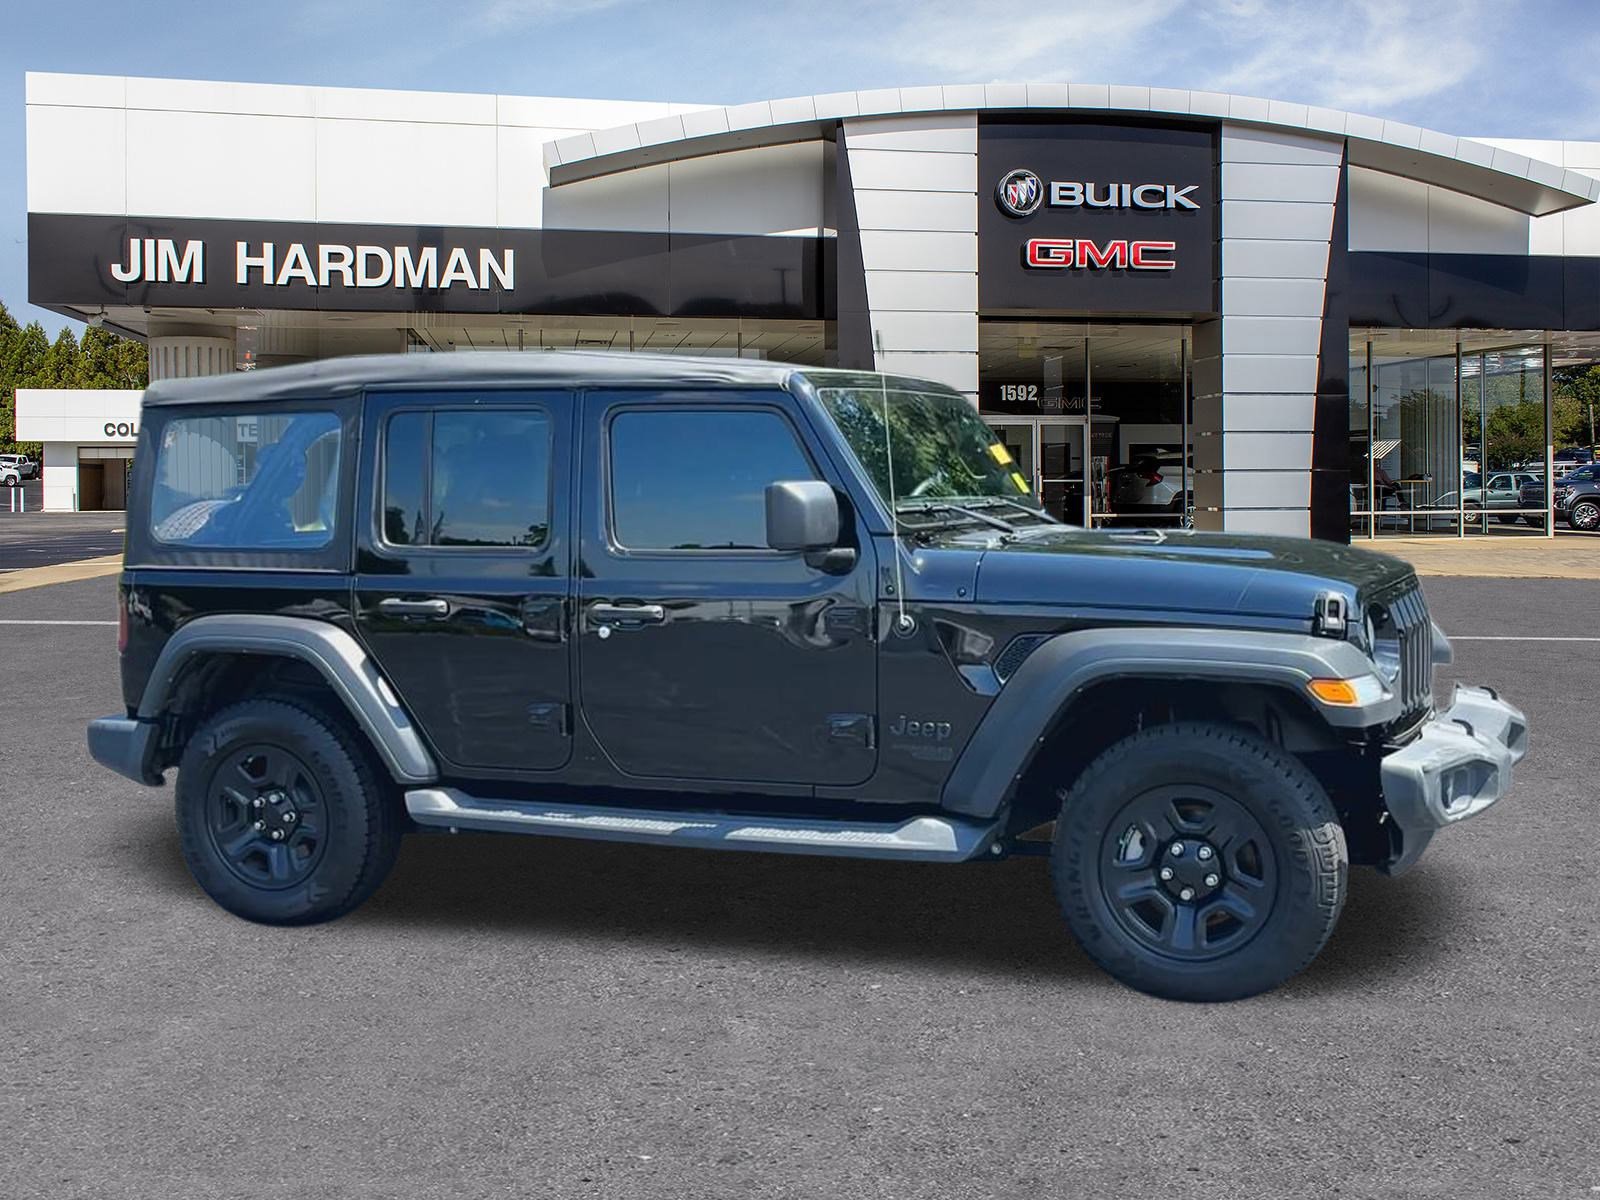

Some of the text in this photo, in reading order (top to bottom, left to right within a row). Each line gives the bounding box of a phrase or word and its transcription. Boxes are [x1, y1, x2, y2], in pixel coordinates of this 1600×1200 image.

[1050, 181, 1200, 208] BUICK
[111, 238, 515, 290] JIM HARDMAN
[1026, 238, 1176, 269] GMC
[1000, 385, 1038, 401] 1592
[1037, 396, 1102, 409] GMC
[889, 715, 952, 740] Jeep
